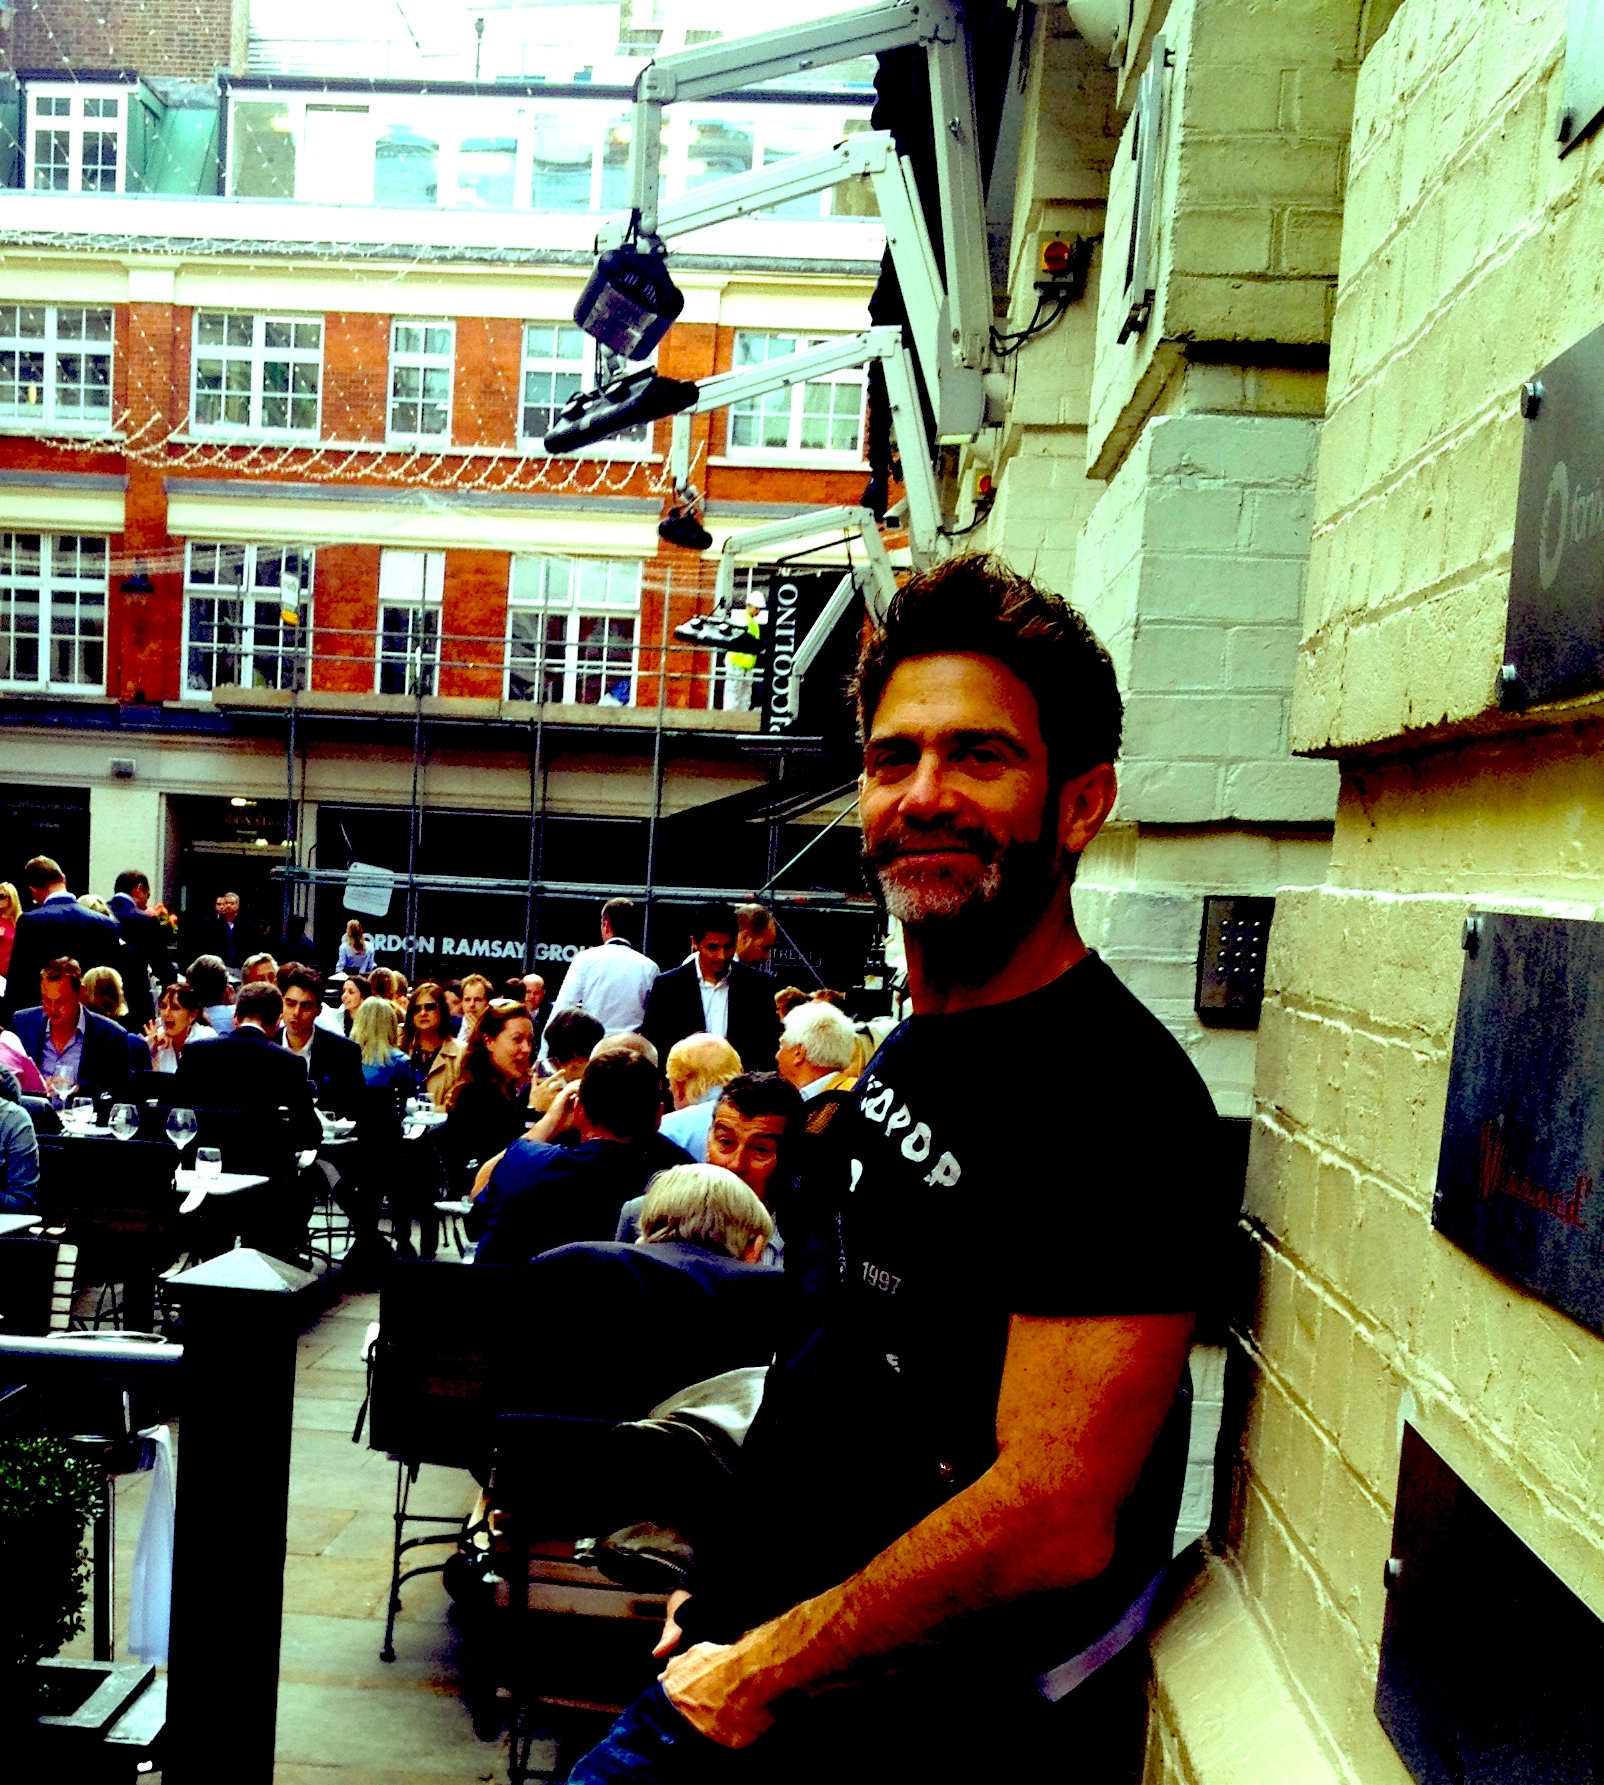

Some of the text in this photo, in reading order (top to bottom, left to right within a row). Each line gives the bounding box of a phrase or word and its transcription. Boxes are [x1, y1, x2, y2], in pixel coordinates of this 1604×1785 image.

[341, 933, 595, 963] ORDON RAMSAY GRO
[863, 1261, 901, 1294] 1997
